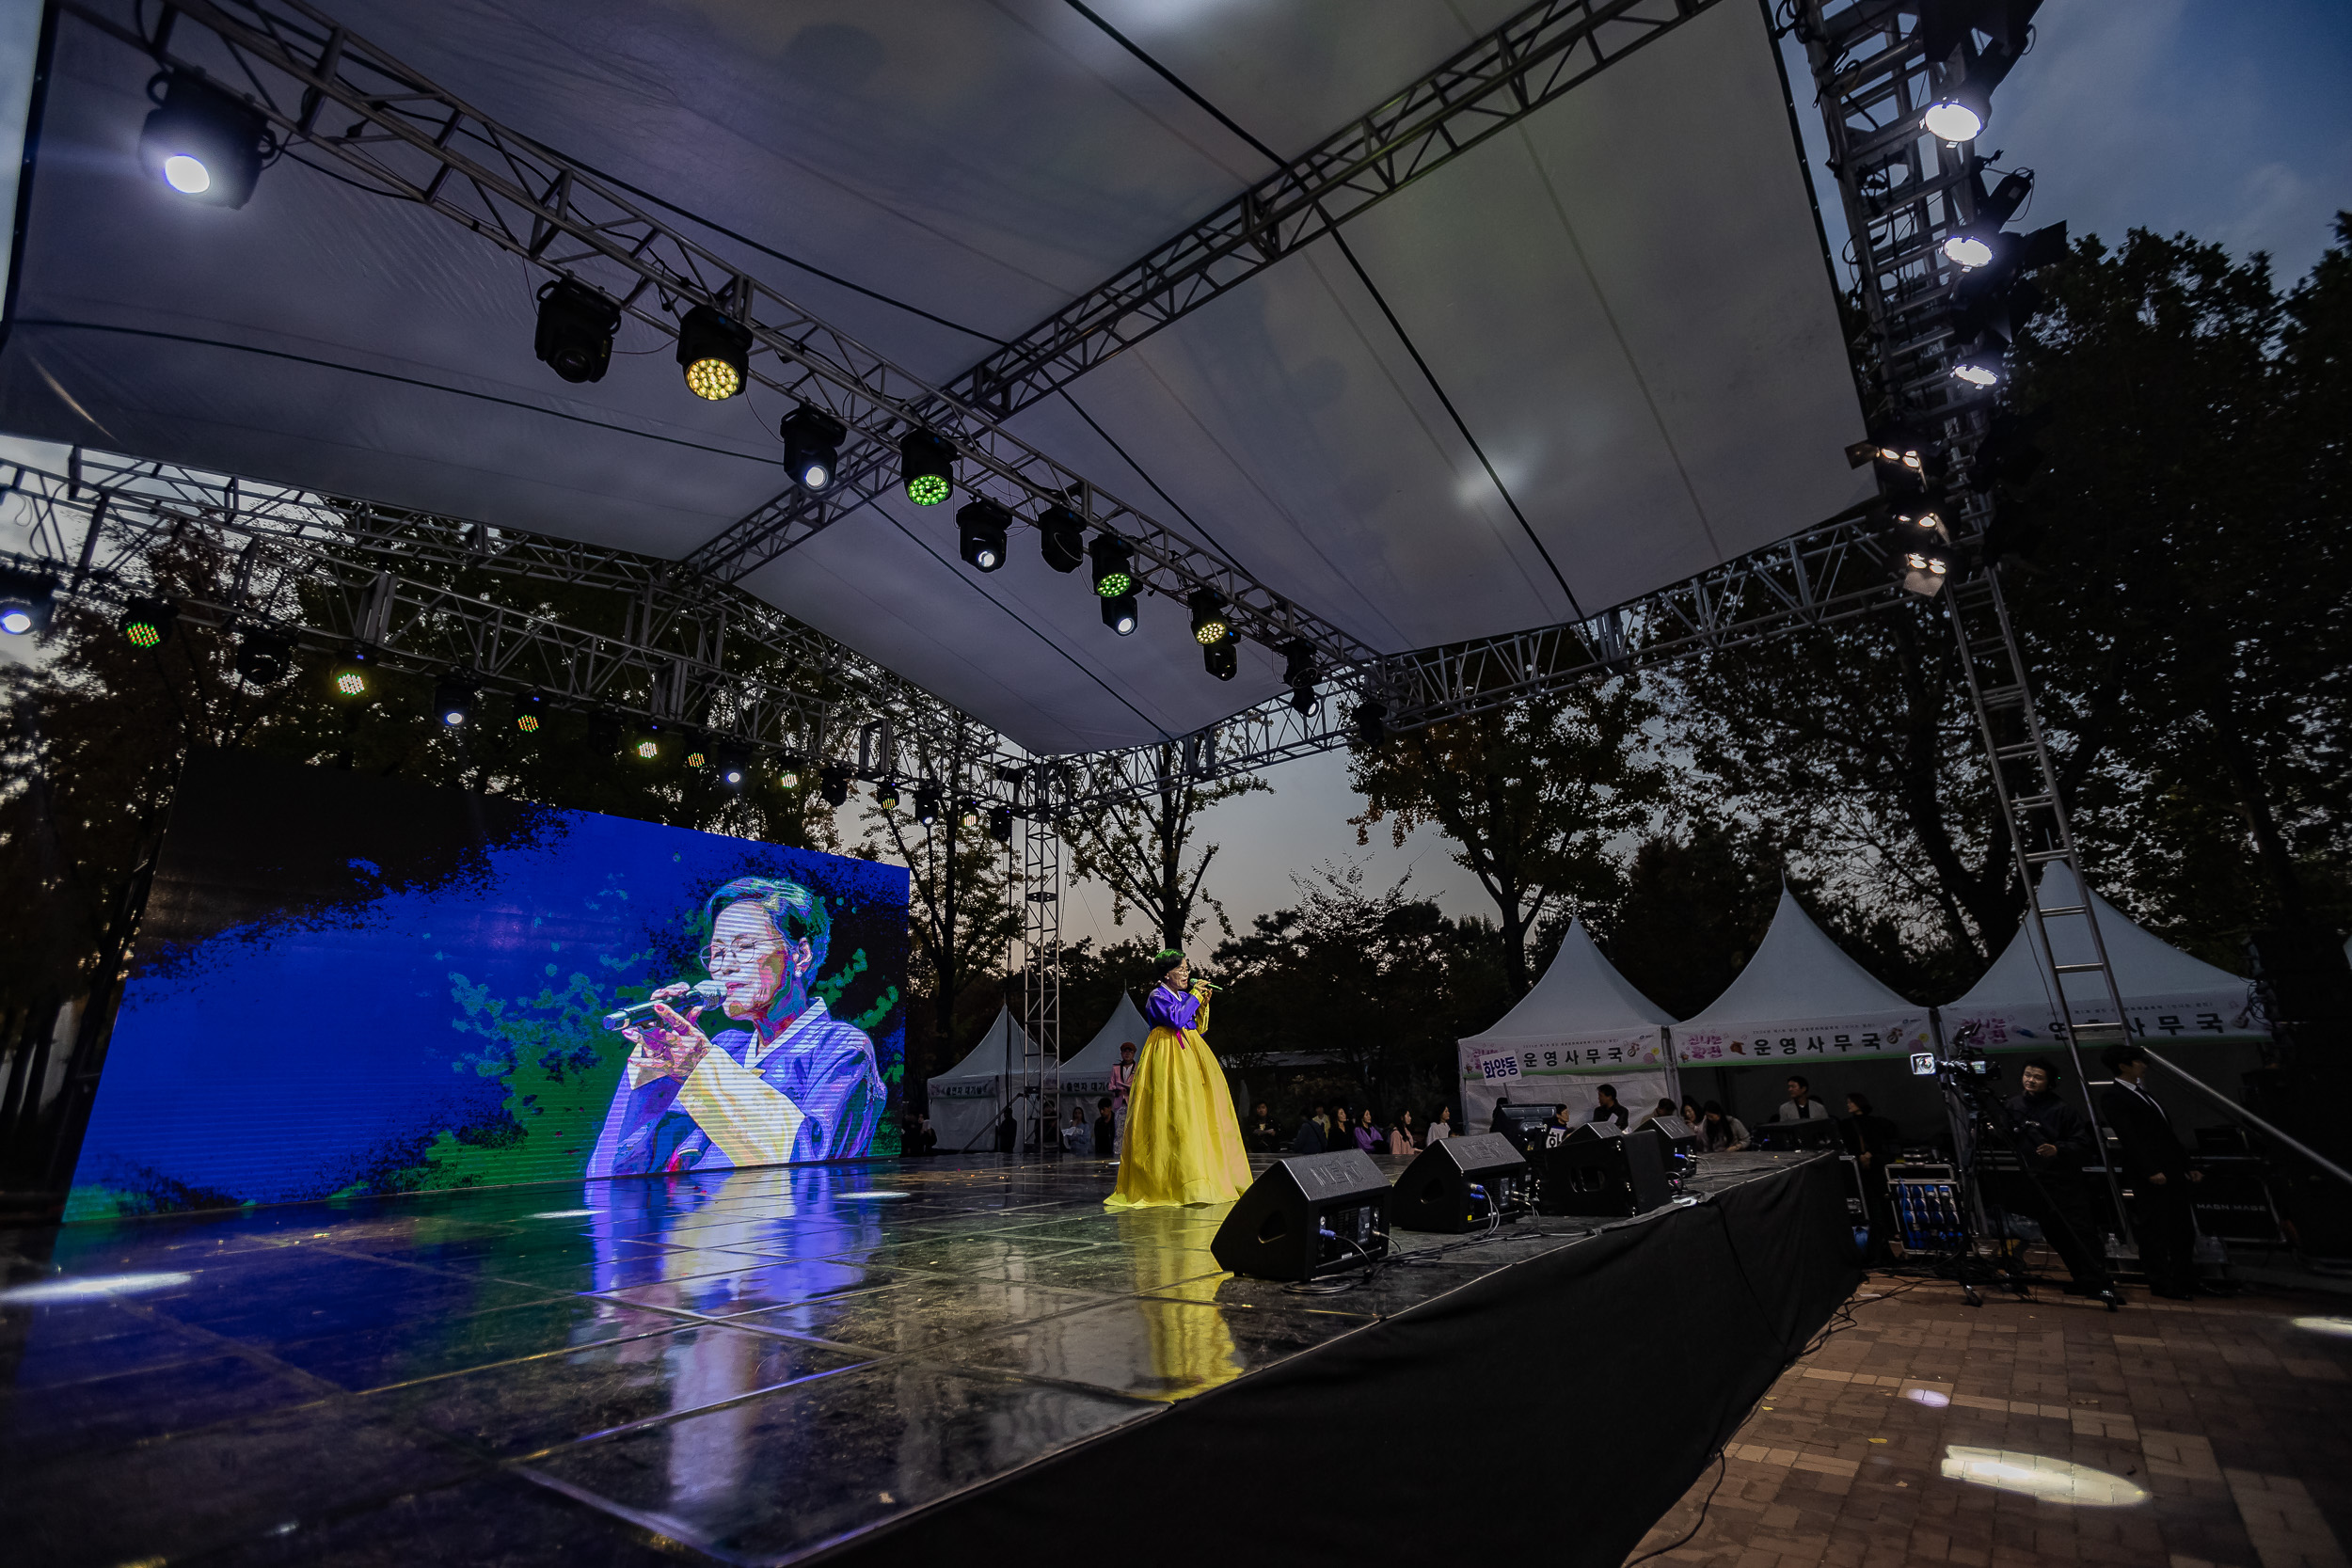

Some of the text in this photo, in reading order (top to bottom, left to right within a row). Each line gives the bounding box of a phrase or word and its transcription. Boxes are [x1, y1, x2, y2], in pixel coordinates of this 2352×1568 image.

[1754, 1033, 1881, 1056] 운영사무국
[1483, 1056, 1518, 1079] 화양동
[1523, 1047, 1623, 1068] 운영사무국
